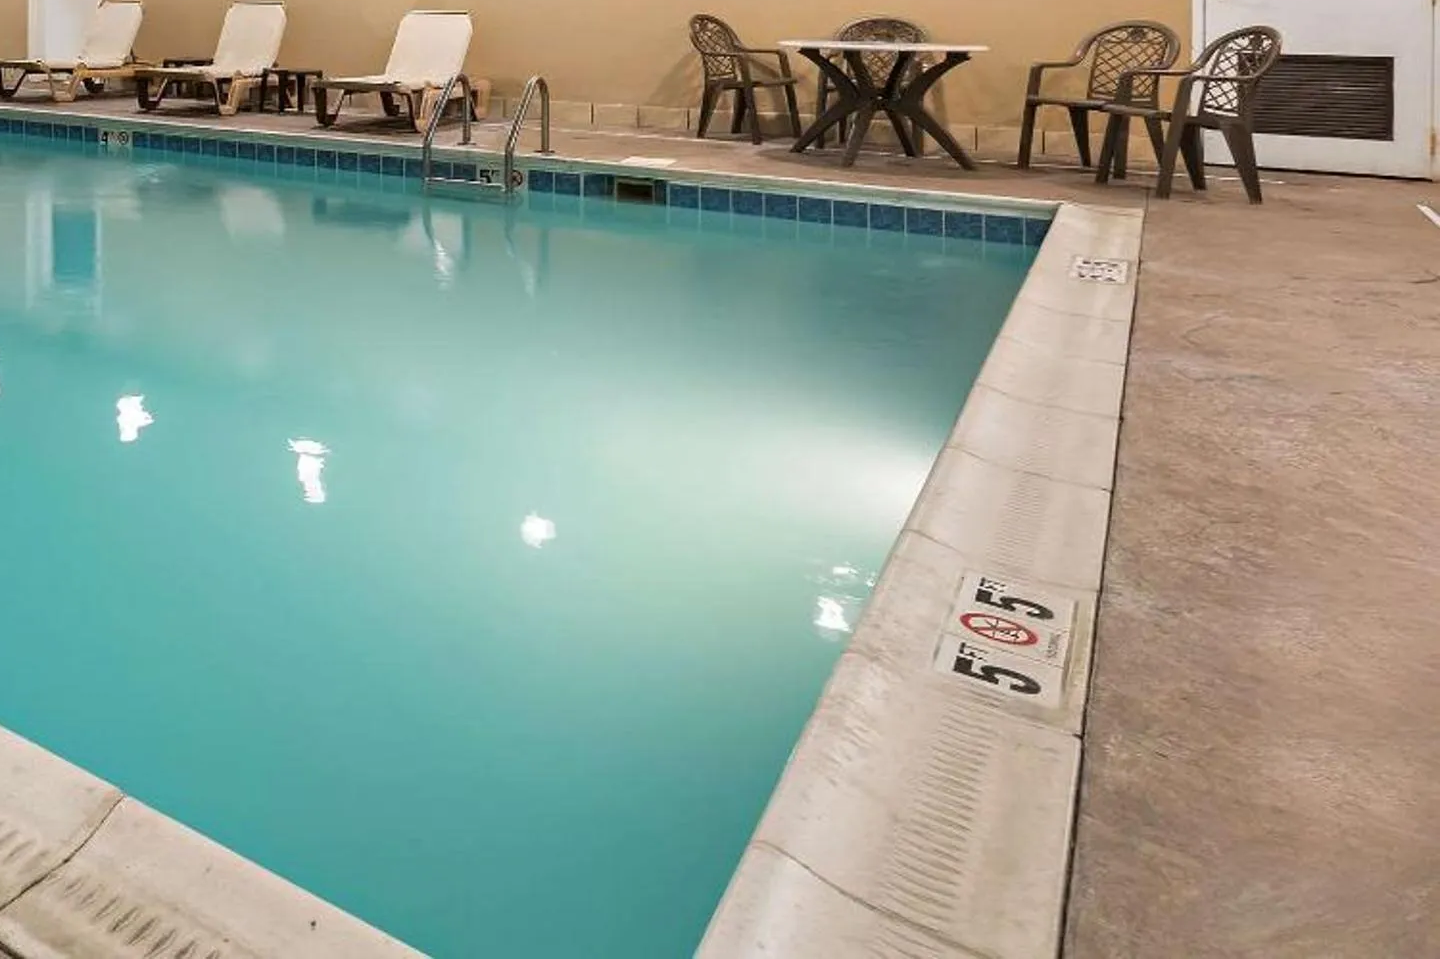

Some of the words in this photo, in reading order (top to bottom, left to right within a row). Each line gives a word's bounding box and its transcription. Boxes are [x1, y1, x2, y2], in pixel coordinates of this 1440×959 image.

[479, 169, 492, 184] 5
[975, 588, 1055, 620] 5
[953, 655, 1042, 694] 5
